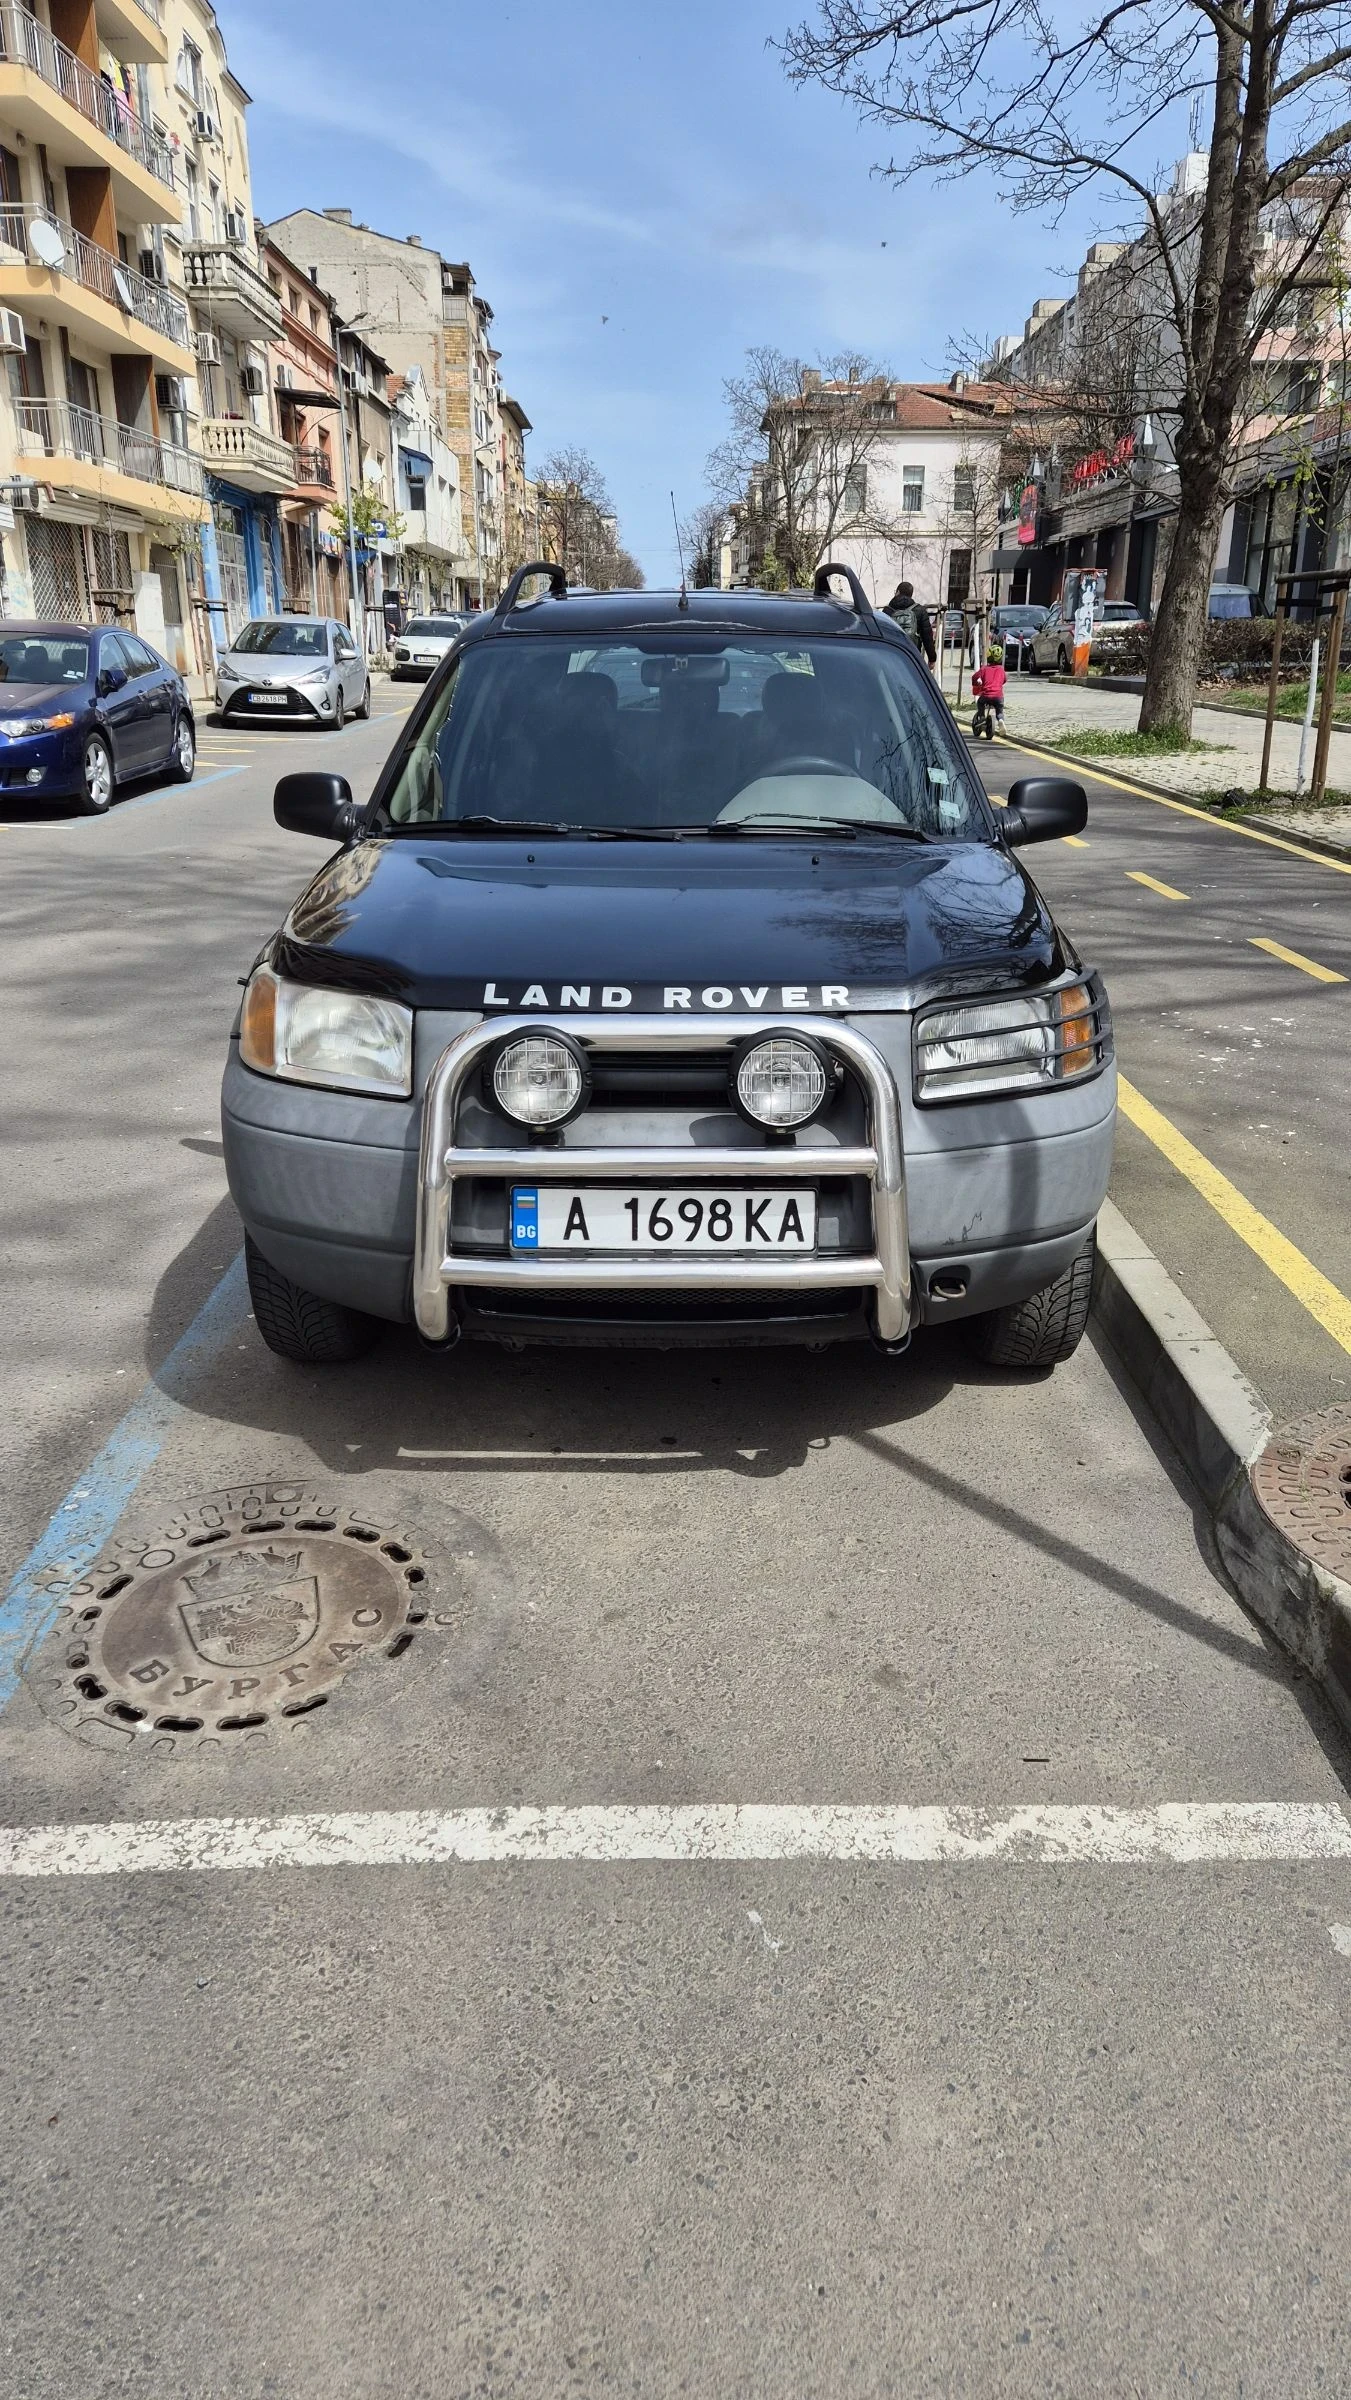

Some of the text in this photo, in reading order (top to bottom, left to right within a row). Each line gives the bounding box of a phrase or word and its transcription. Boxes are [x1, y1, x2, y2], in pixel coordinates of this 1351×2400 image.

[483, 983, 850, 1009] LAND ROVER
[516, 1225, 536, 1238] BG
[129, 1608, 382, 1700] БУРГАС
